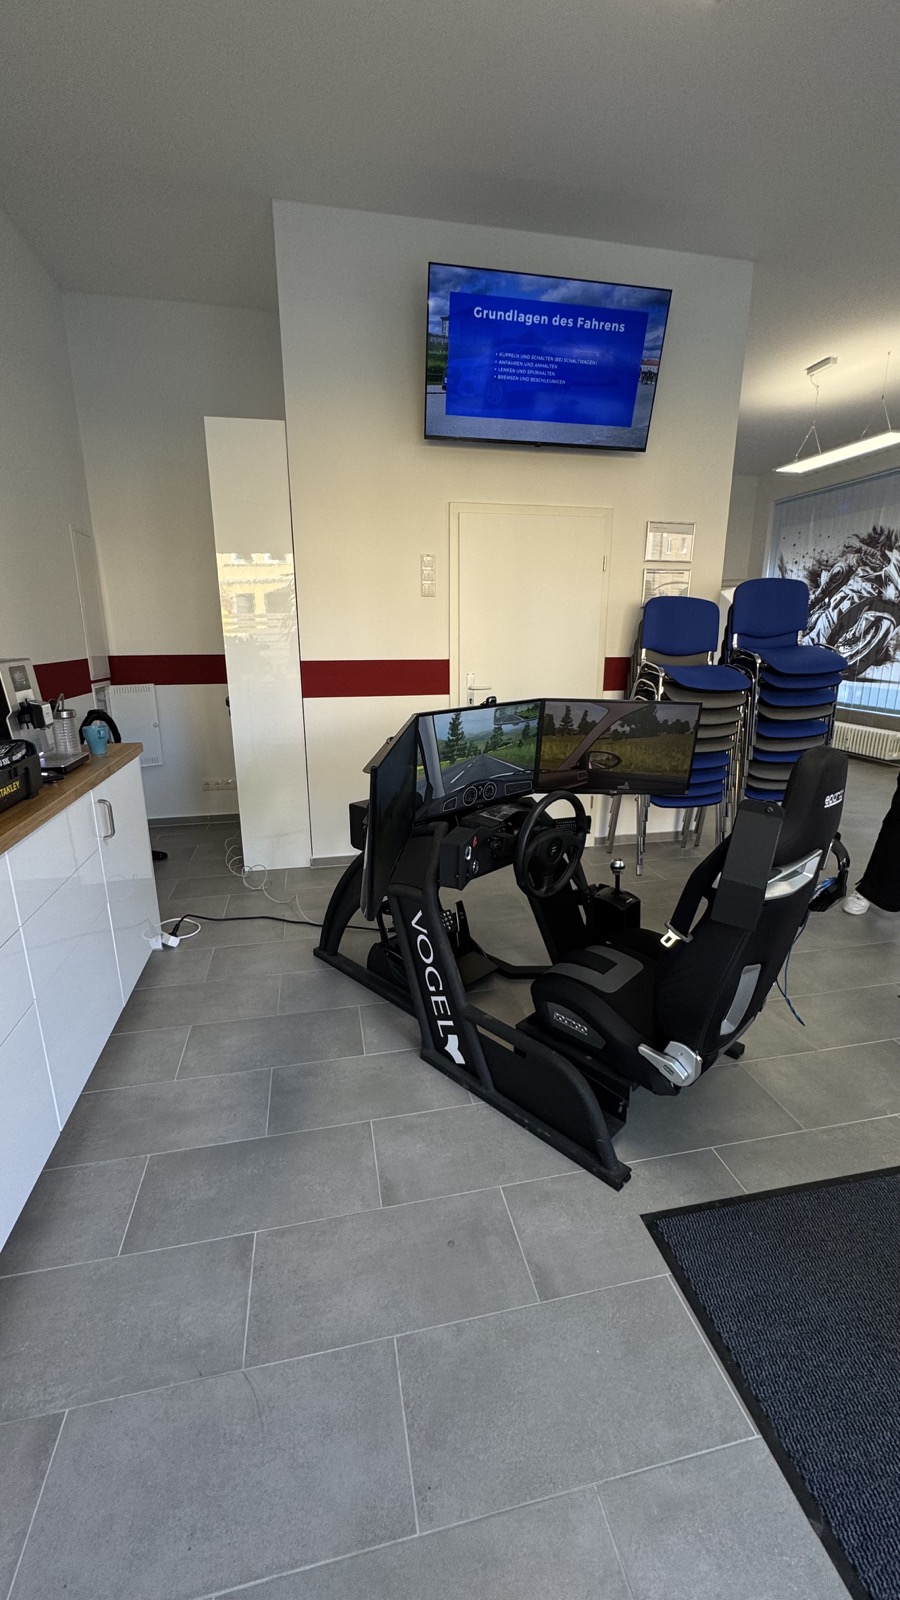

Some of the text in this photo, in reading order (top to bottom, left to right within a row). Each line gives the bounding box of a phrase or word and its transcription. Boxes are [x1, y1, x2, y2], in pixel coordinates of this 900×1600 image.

[473, 306, 625, 333] Grundlagen des Fahrens
[531, 354, 554, 362] SCHALTEN
[534, 362, 558, 370] ANHALTEN
[411, 909, 455, 1038] VOGEL
